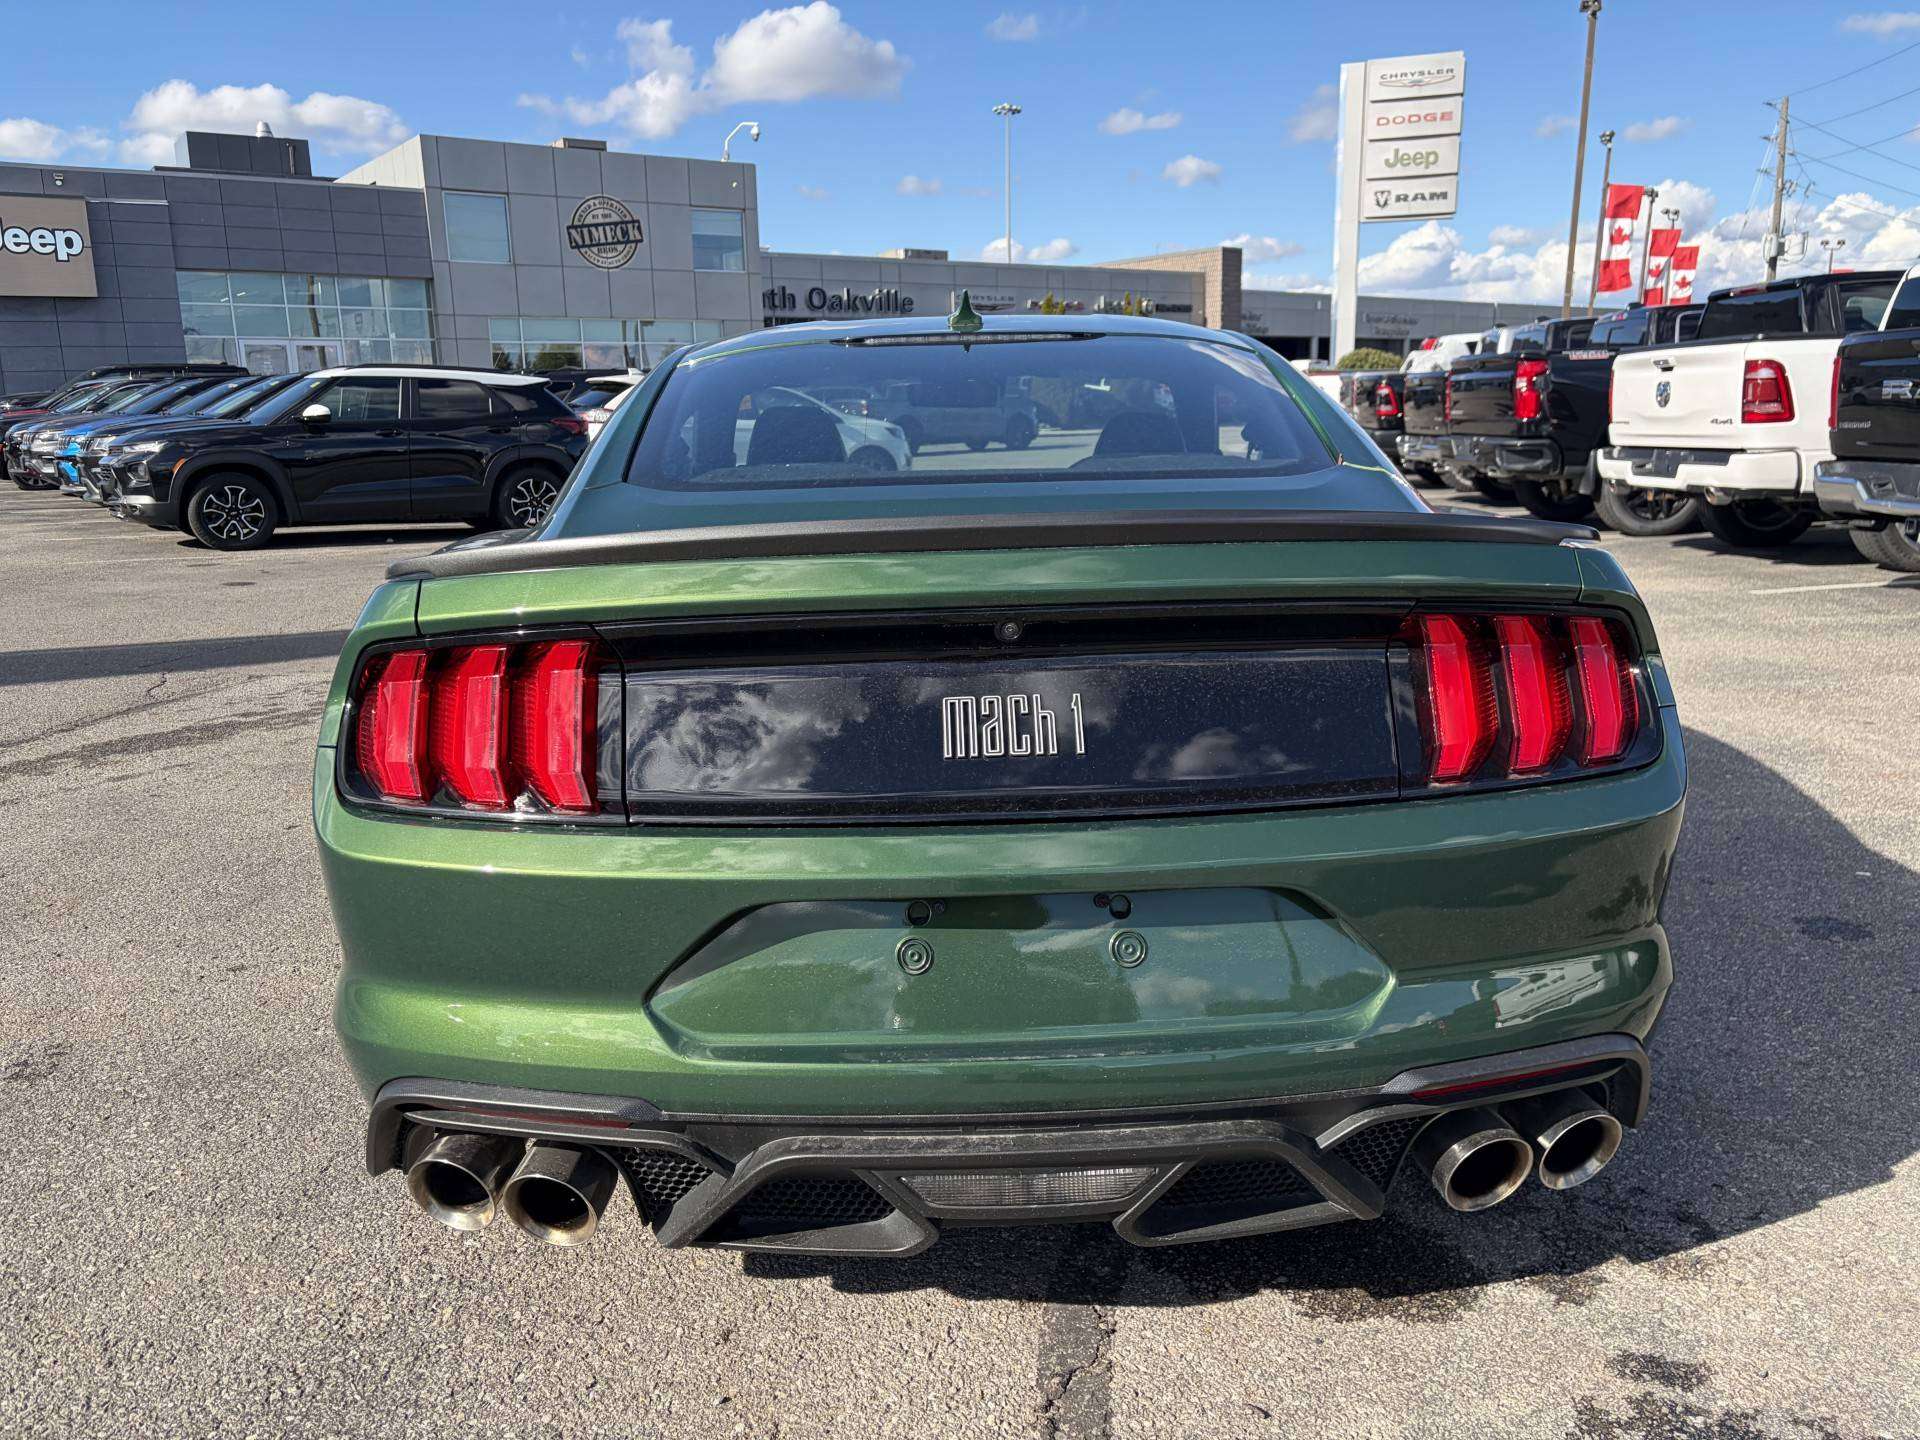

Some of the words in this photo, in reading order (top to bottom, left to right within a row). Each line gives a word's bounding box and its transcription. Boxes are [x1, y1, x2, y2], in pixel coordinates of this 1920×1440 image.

[1379, 68, 1455, 80] CHRYSLER
[1376, 111, 1454, 127] DODGE
[1384, 148, 1440, 169] Jeep
[1394, 191, 1448, 203] RAM
[0, 216, 84, 262] eep
[568, 223, 642, 247] NIMECK
[806, 286, 915, 314] Oakville
[1070, 692, 1086, 756] 1
